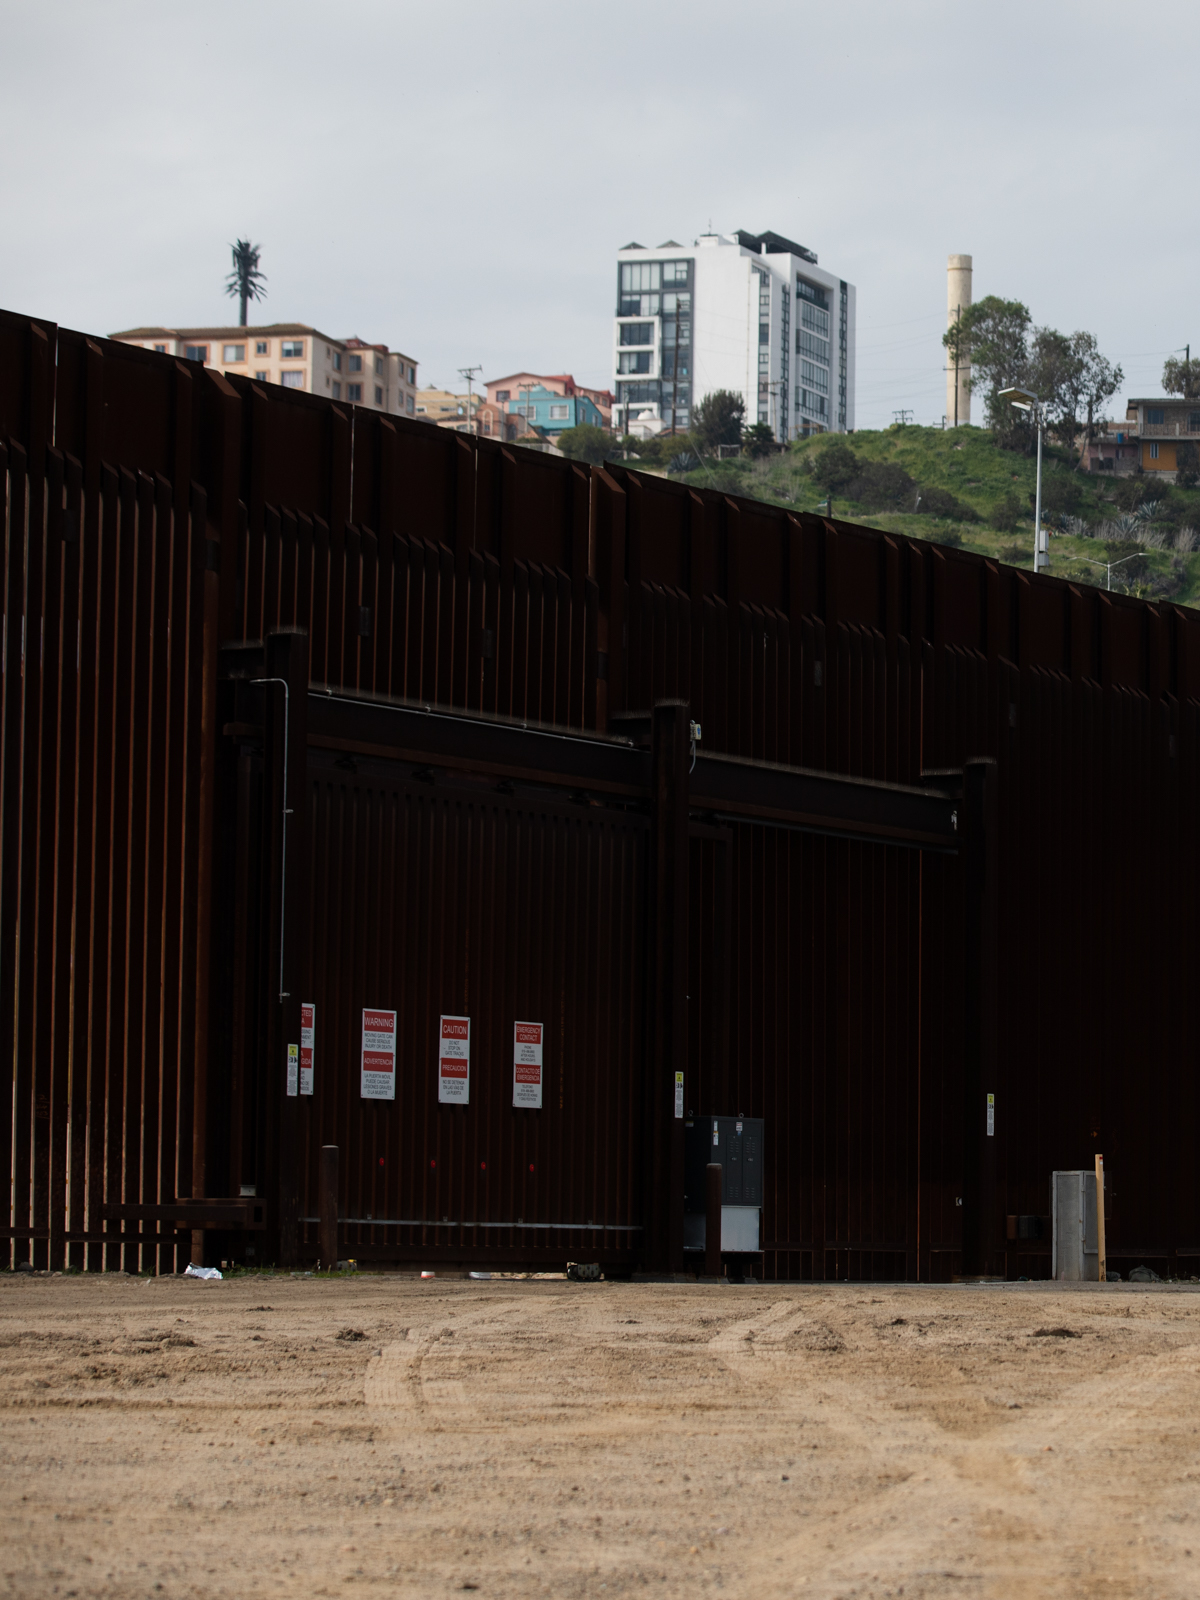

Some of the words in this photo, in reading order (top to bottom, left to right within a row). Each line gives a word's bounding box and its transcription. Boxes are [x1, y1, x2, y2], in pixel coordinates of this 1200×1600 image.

[364, 1017, 394, 1028] WARNING
[443, 1024, 467, 1035] CAUTION
[517, 1026, 540, 1034] EMERGENCY
